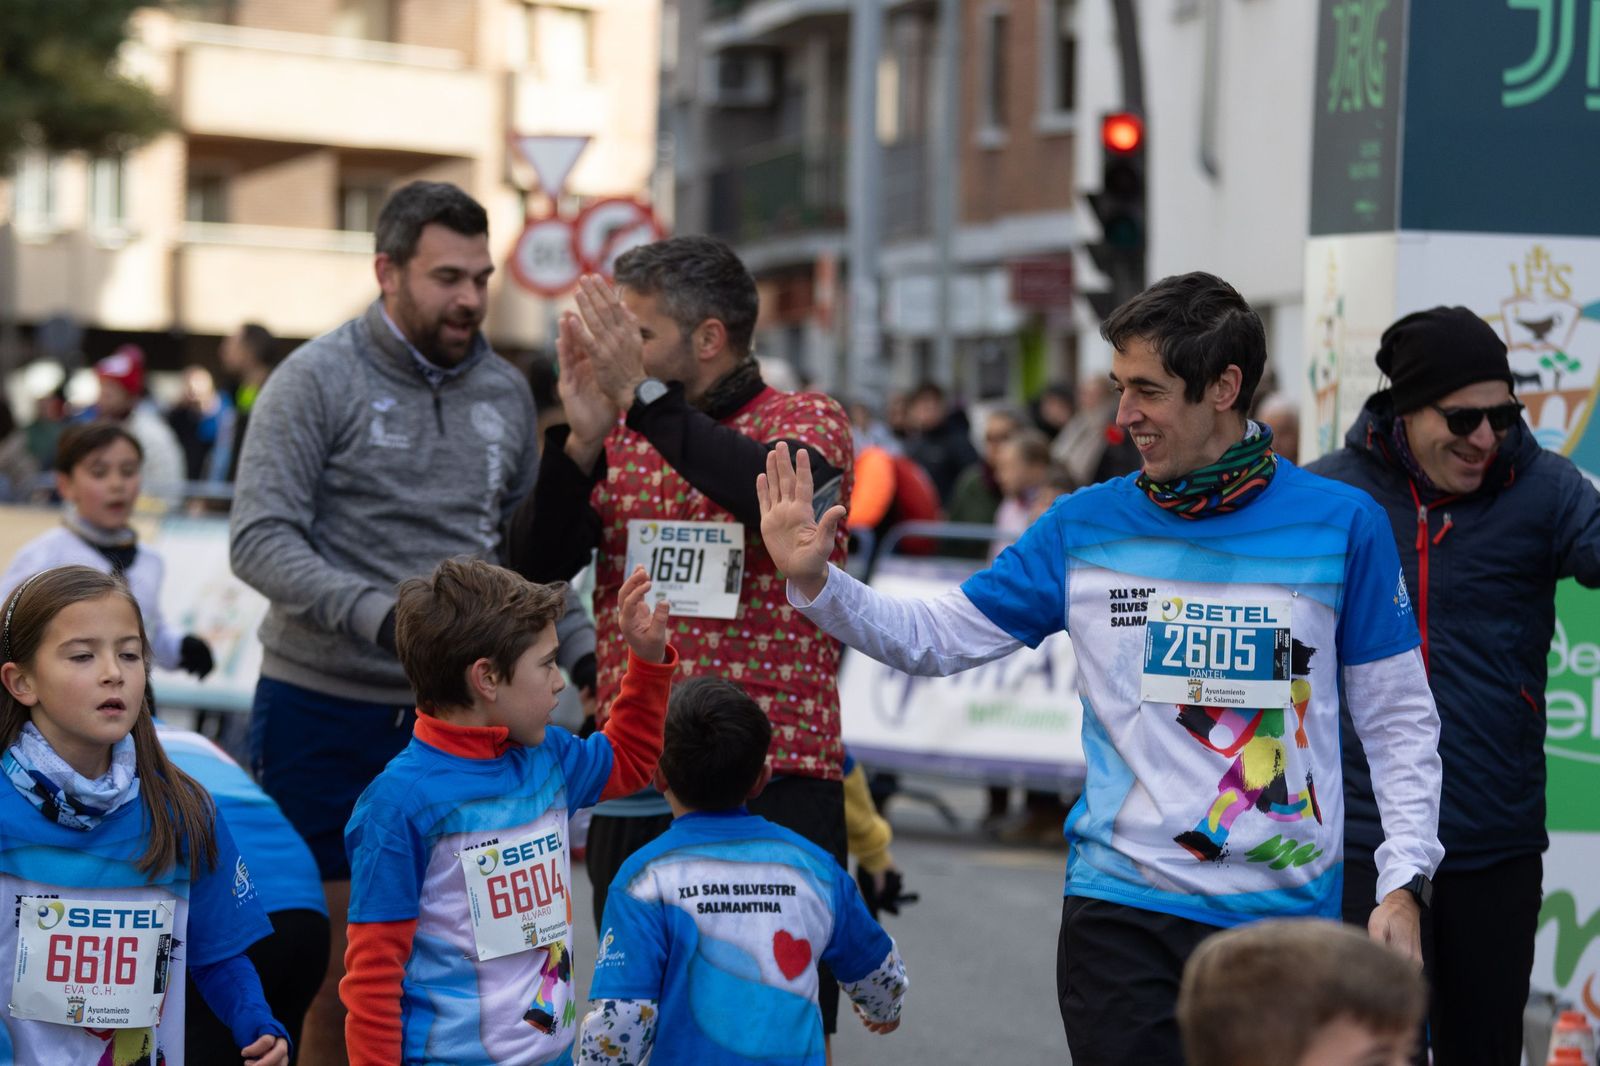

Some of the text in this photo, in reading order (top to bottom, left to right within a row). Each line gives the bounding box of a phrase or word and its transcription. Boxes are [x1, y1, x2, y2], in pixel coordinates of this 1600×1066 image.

[661, 527, 732, 544] SETEL
[650, 547, 705, 584] 1691
[1109, 588, 1128, 600] XLI
[1110, 601, 1148, 613] SILVES
[1185, 602, 1278, 623] SETEL
[1162, 624, 1256, 672] 2605
[1190, 668, 1226, 680] DANIEL
[1204, 687, 1246, 696] Ayuntamiento
[1213, 696, 1245, 704] Salamanca
[502, 831, 562, 867] SETEL
[486, 857, 565, 920] 6604
[678, 883, 796, 900] XLI SAN SILVESTRE
[697, 901, 782, 914] SALMANTINA
[68, 908, 164, 929] SETEL
[46, 934, 139, 985] 6616
[64, 984, 85, 994] EVA
[87, 1006, 130, 1014] Ayuntamiento
[96, 1016, 129, 1024] Salamanca
